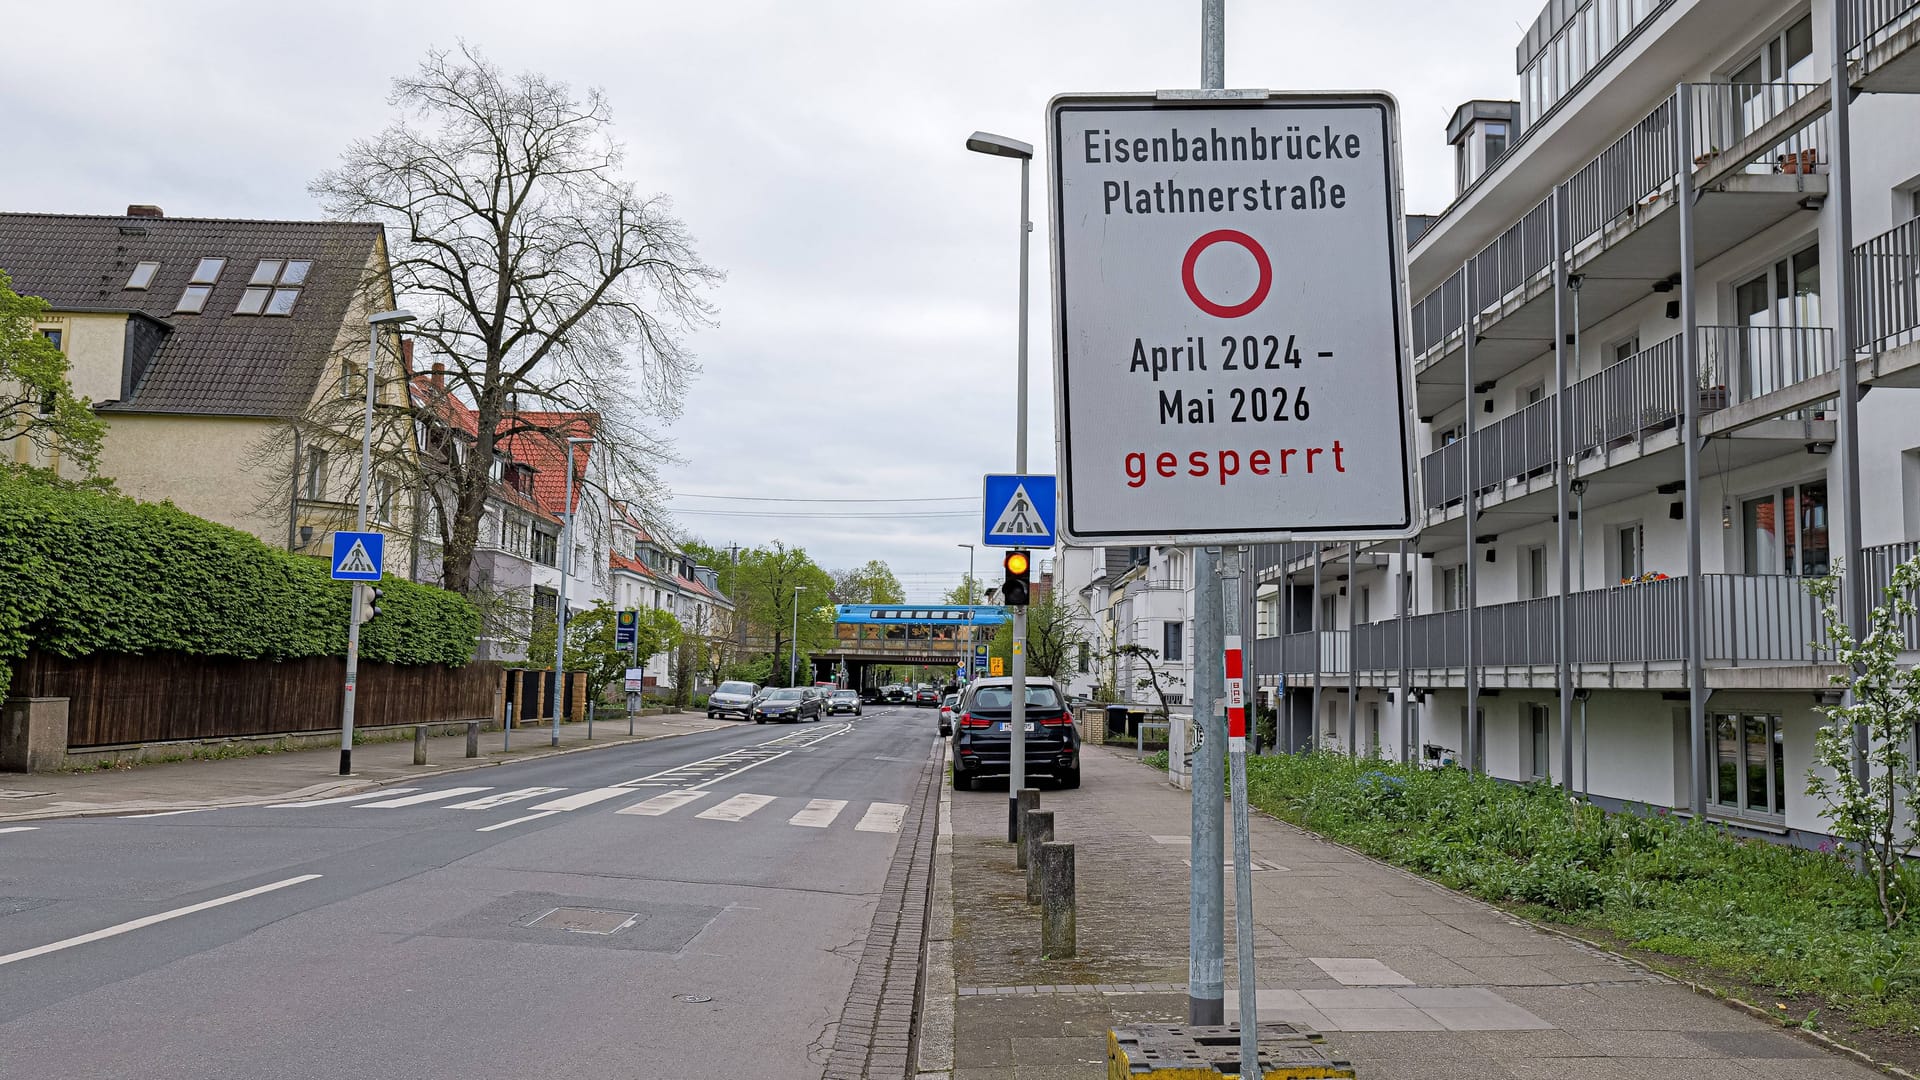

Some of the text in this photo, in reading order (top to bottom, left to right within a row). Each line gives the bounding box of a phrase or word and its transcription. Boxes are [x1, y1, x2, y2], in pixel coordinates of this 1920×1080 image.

[1085, 126, 1361, 164] Eisenbahnbrücke
[1104, 176, 1346, 214] Plathnerstraße
[1130, 337, 1207, 381] April
[1222, 335, 1302, 371] 2024
[1159, 387, 1310, 424] Mai 2026
[1125, 441, 1345, 487] gesperrt
